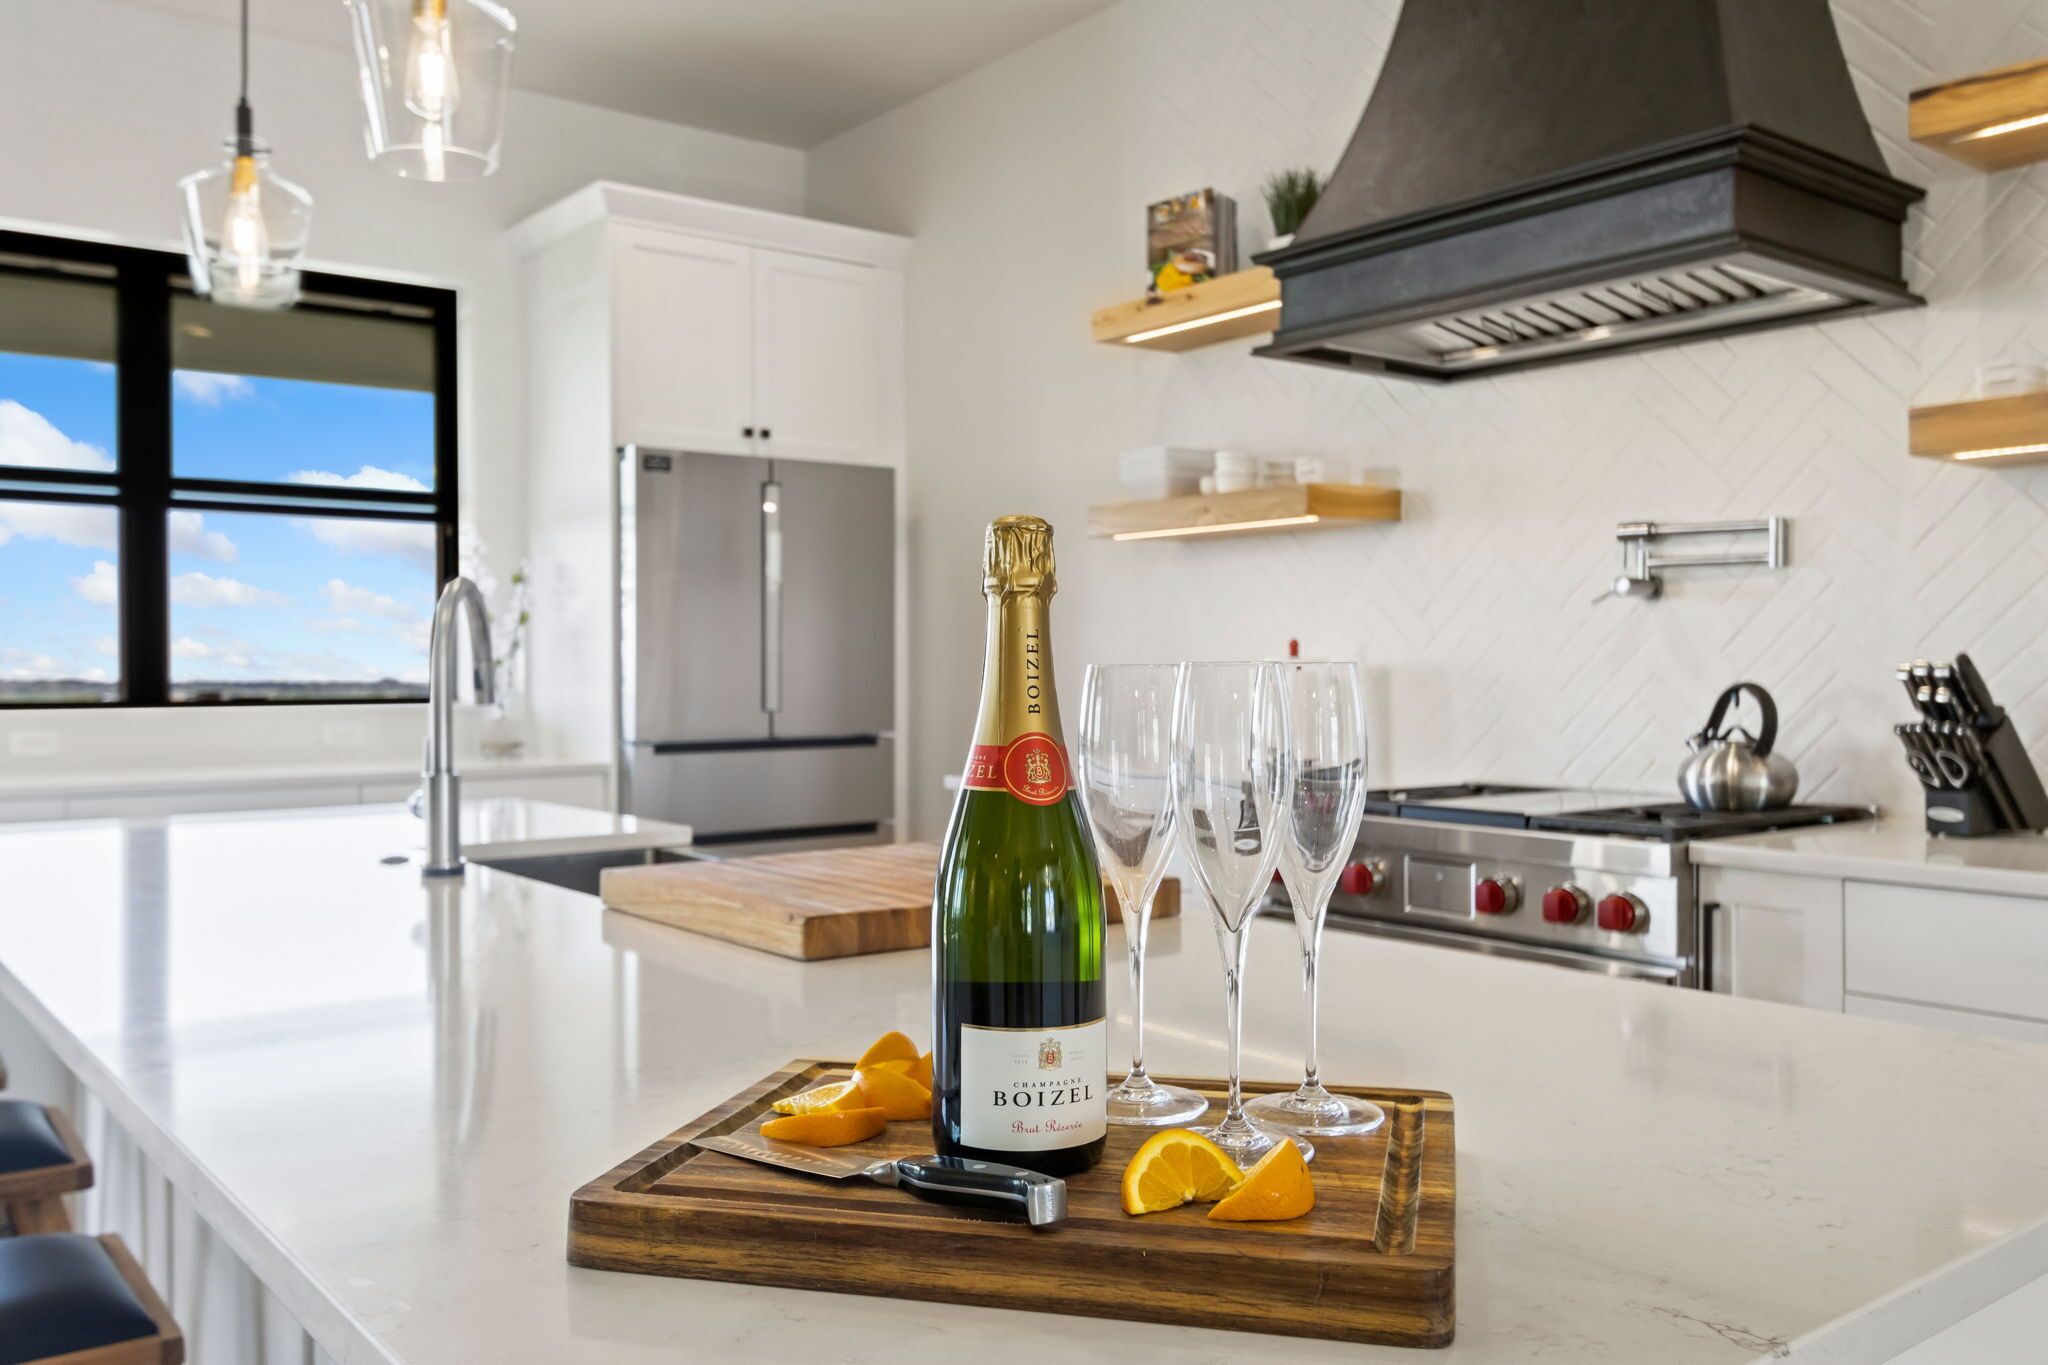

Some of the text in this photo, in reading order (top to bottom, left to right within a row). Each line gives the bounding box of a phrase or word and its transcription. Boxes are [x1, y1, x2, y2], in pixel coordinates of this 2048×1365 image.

[1026, 629, 1041, 714] BOIZEL
[1013, 1077, 1082, 1088] CHAMPAGNE
[993, 1085, 1093, 1107] BOIZEL
[1011, 1120, 1040, 1134] Brut
